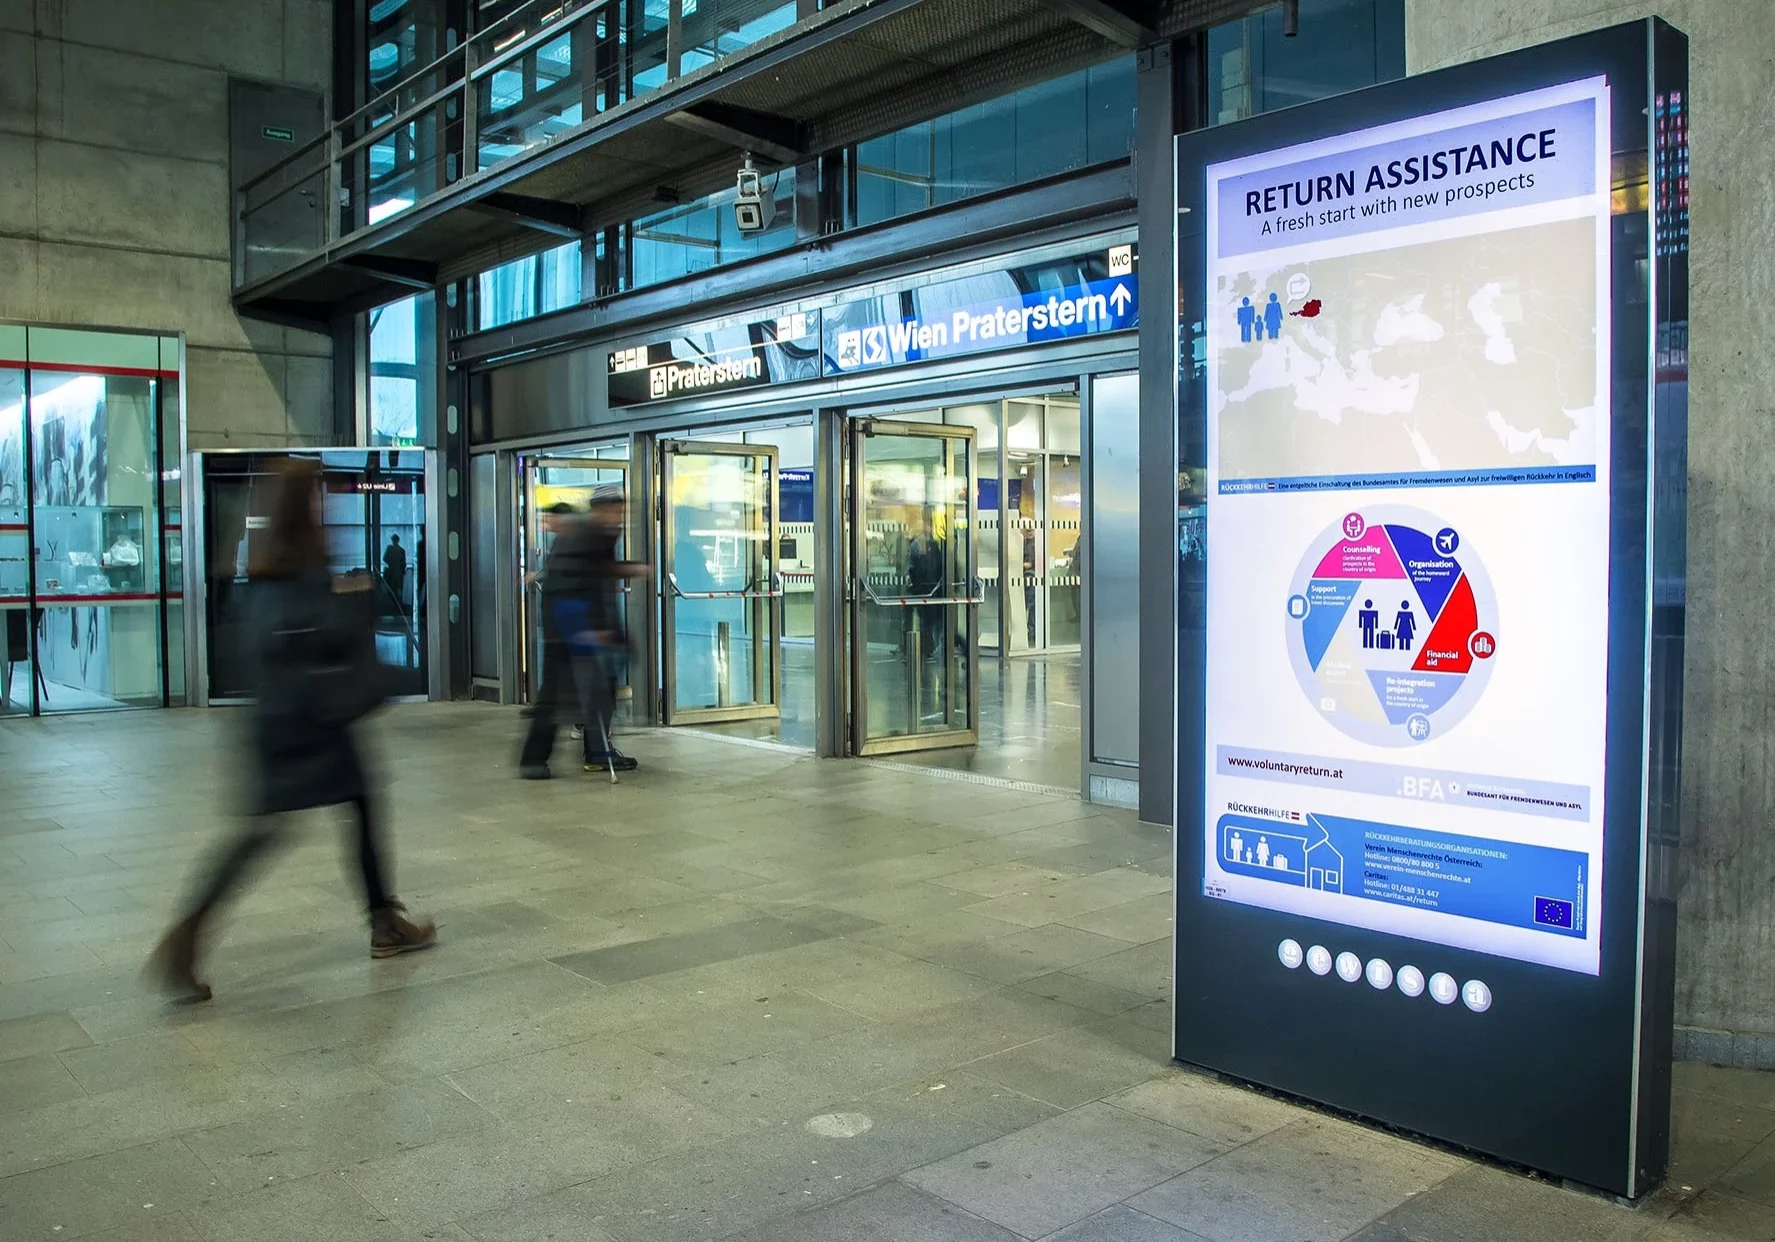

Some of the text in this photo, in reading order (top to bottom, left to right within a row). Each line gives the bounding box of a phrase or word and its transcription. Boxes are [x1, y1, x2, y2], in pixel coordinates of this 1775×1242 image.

[1245, 129, 1556, 216] RETURN ASSISTANCE
[1261, 172, 1535, 236] A fresh start with new prospects
[1111, 253, 1130, 267] WC
[887, 293, 1107, 355] Wien Praterstern
[667, 356, 762, 392] Praterstern
[1318, 481, 1351, 489] Einschaltung
[1362, 479, 1399, 487] Bundesamtes
[1467, 476, 1480, 484] Asyl
[1564, 471, 1591, 480] Englisch
[1342, 545, 1381, 555] Counselling
[1409, 560, 1454, 570] Organisation
[1311, 585, 1336, 594] Support
[1426, 650, 1459, 659] Financial
[1426, 658, 1438, 666] aid
[1386, 676, 1436, 688] Re-integration
[1386, 686, 1414, 695] projects
[1228, 756, 1343, 779] www.voluntaryreturn.at
[1467, 790, 1498, 800] BUNDESAMT
[1510, 796, 1555, 807] FREMDENWESEN
[1568, 802, 1582, 810] ASYL
[1227, 801, 1290, 820] RÜCKKEHRHILFE
[1364, 831, 1508, 860] RÜCKKEHRBERATUNGSORGANISATIONEN:
[1364, 843, 1483, 869] Verein Menschenrechte Österreich:
[1364, 851, 1391, 862] Hotline:
[1364, 861, 1471, 884] www.verein-menschenrechte.at
[1364, 870, 1388, 881] Caritas:
[1363, 887, 1438, 907] www.caritas.at/return
[1364, 879, 1439, 898] Hotline: 01/488 31 447
